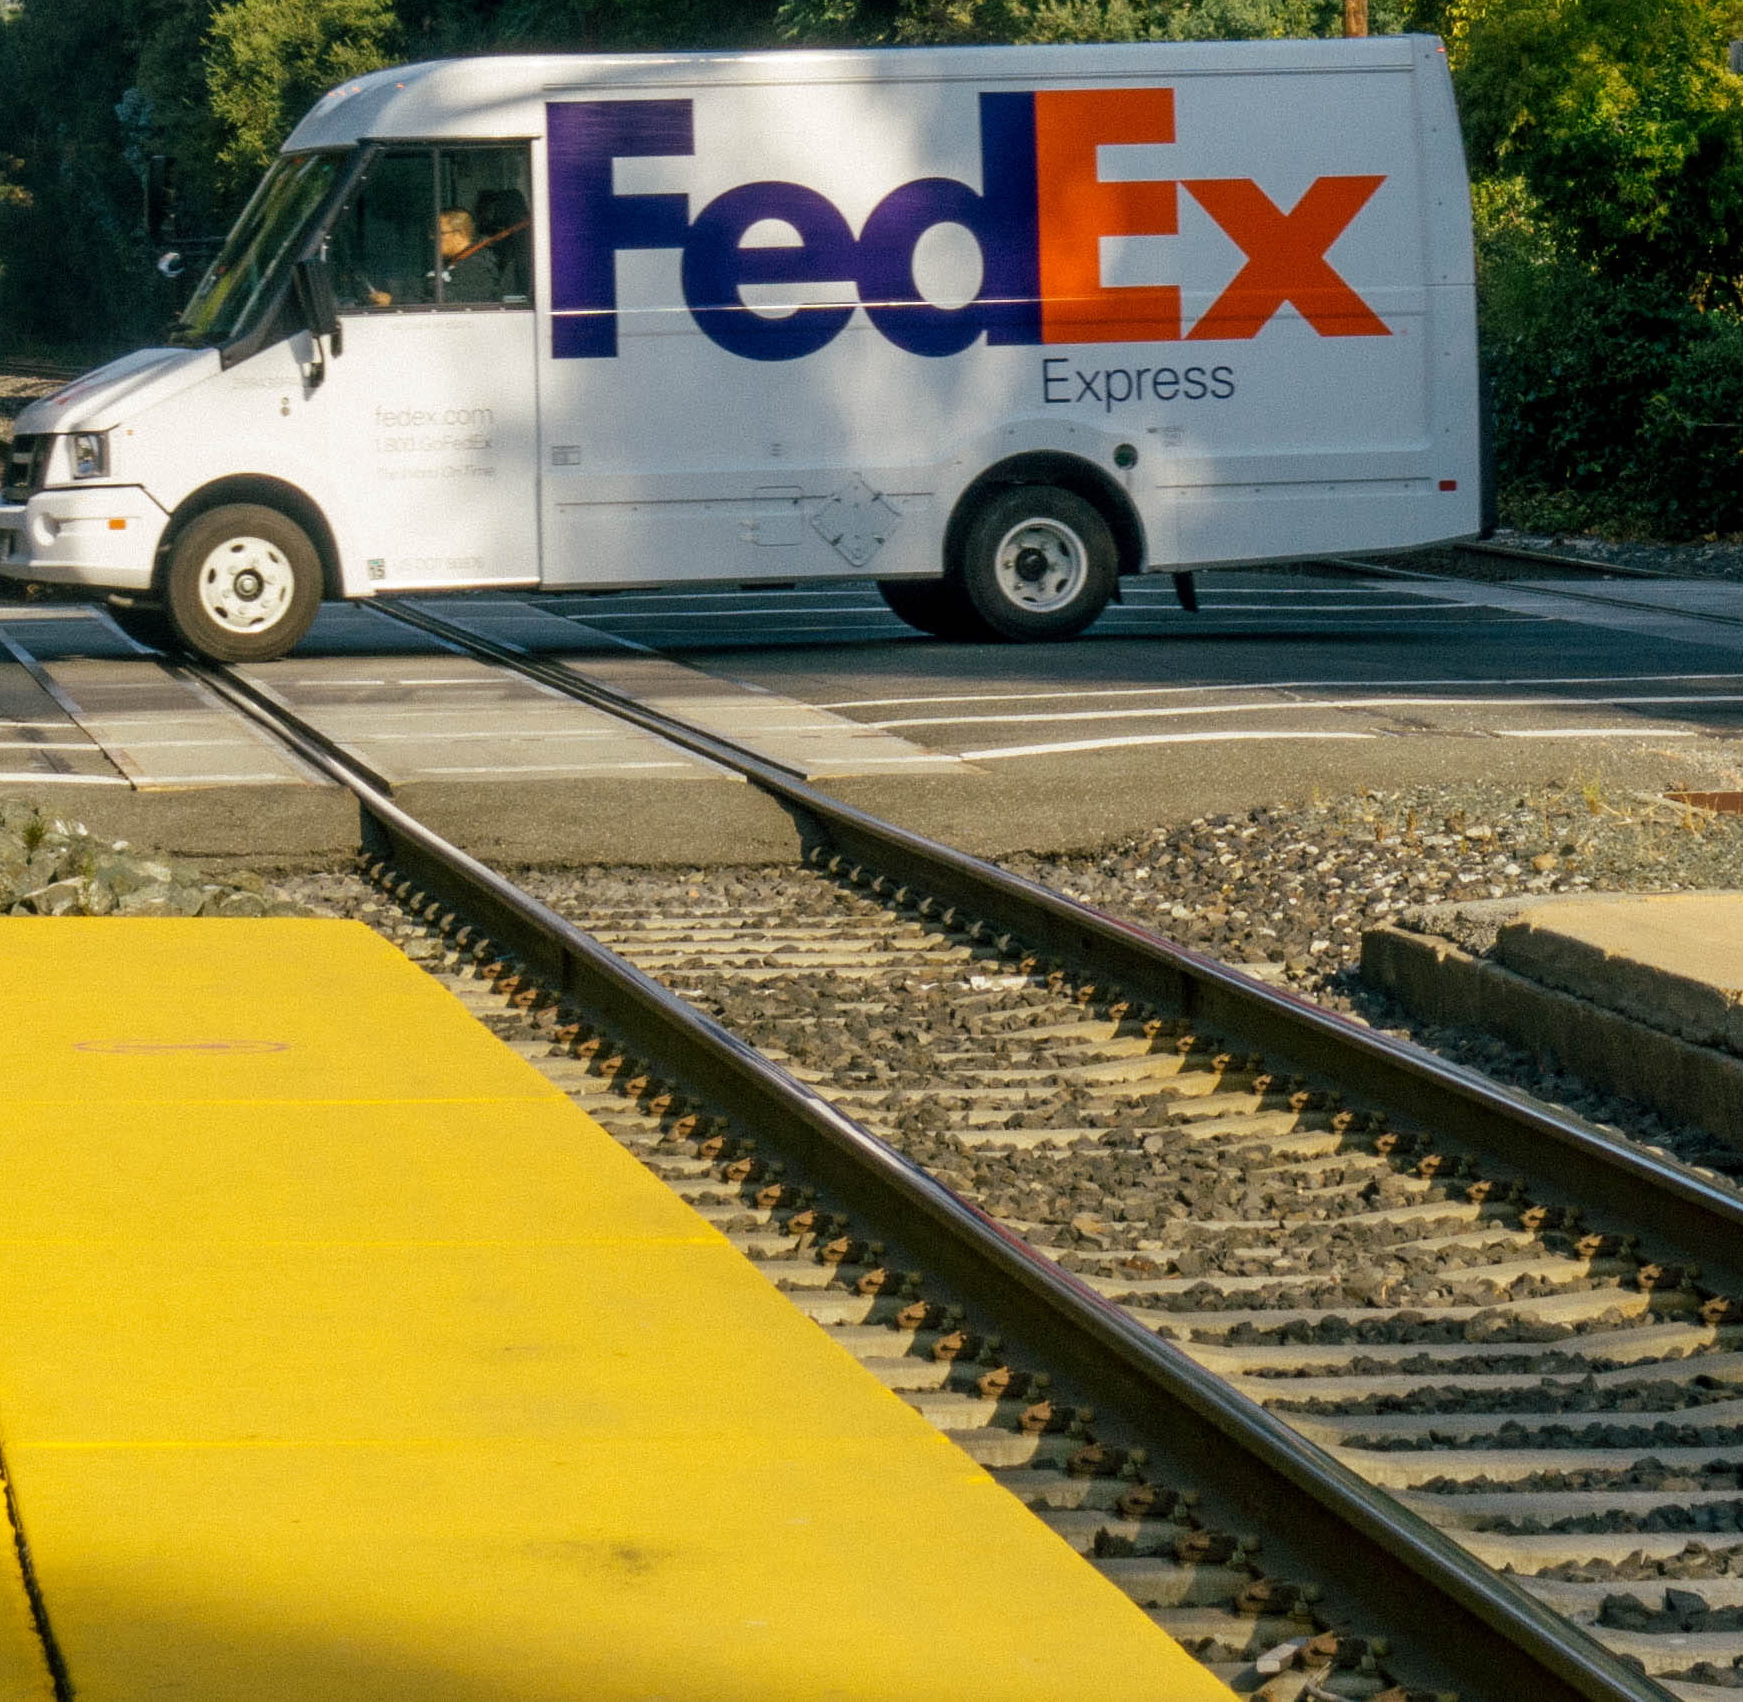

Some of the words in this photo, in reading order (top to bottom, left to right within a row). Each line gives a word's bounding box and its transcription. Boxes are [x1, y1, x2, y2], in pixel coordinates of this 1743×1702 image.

[545, 88, 1395, 362] FedEx
[1042, 357, 1236, 413] Express
[375, 404, 495, 428] fedex.com
